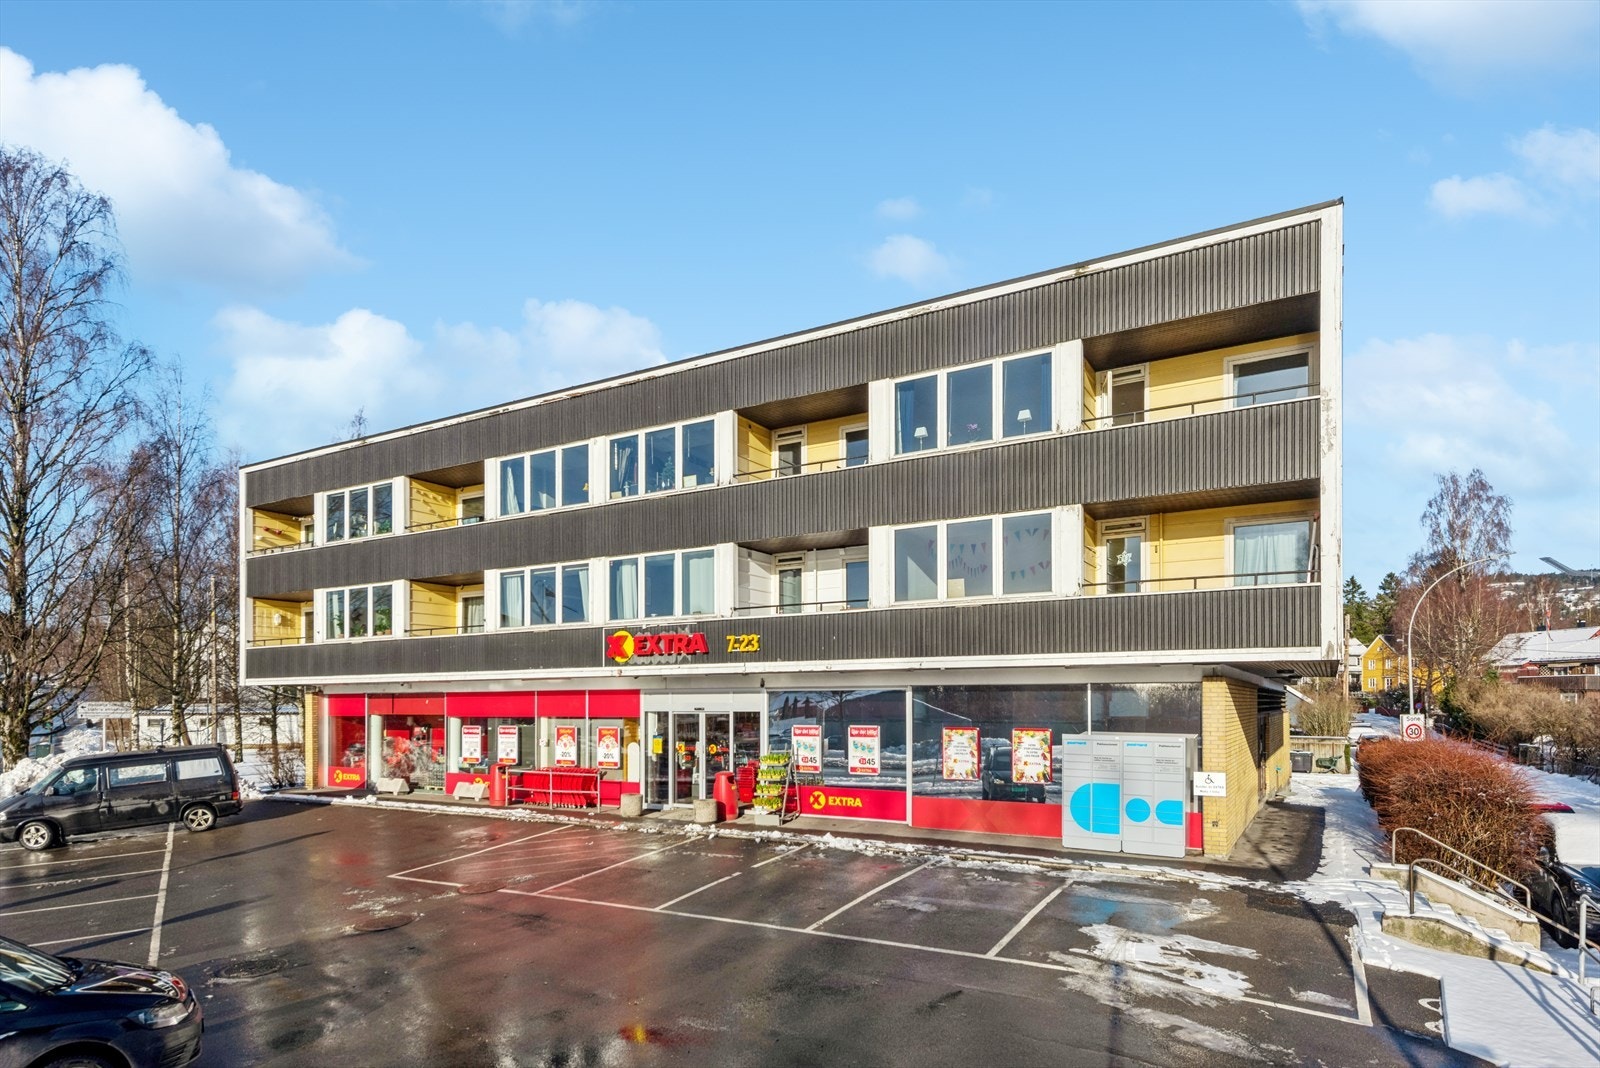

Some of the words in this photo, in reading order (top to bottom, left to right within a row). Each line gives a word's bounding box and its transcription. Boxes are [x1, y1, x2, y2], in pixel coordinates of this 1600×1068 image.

[634, 633, 708, 656] EXTRA
[726, 634, 760, 652] 7-23
[343, 773, 360, 781] EXTRA
[828, 796, 863, 807] EXTRA
